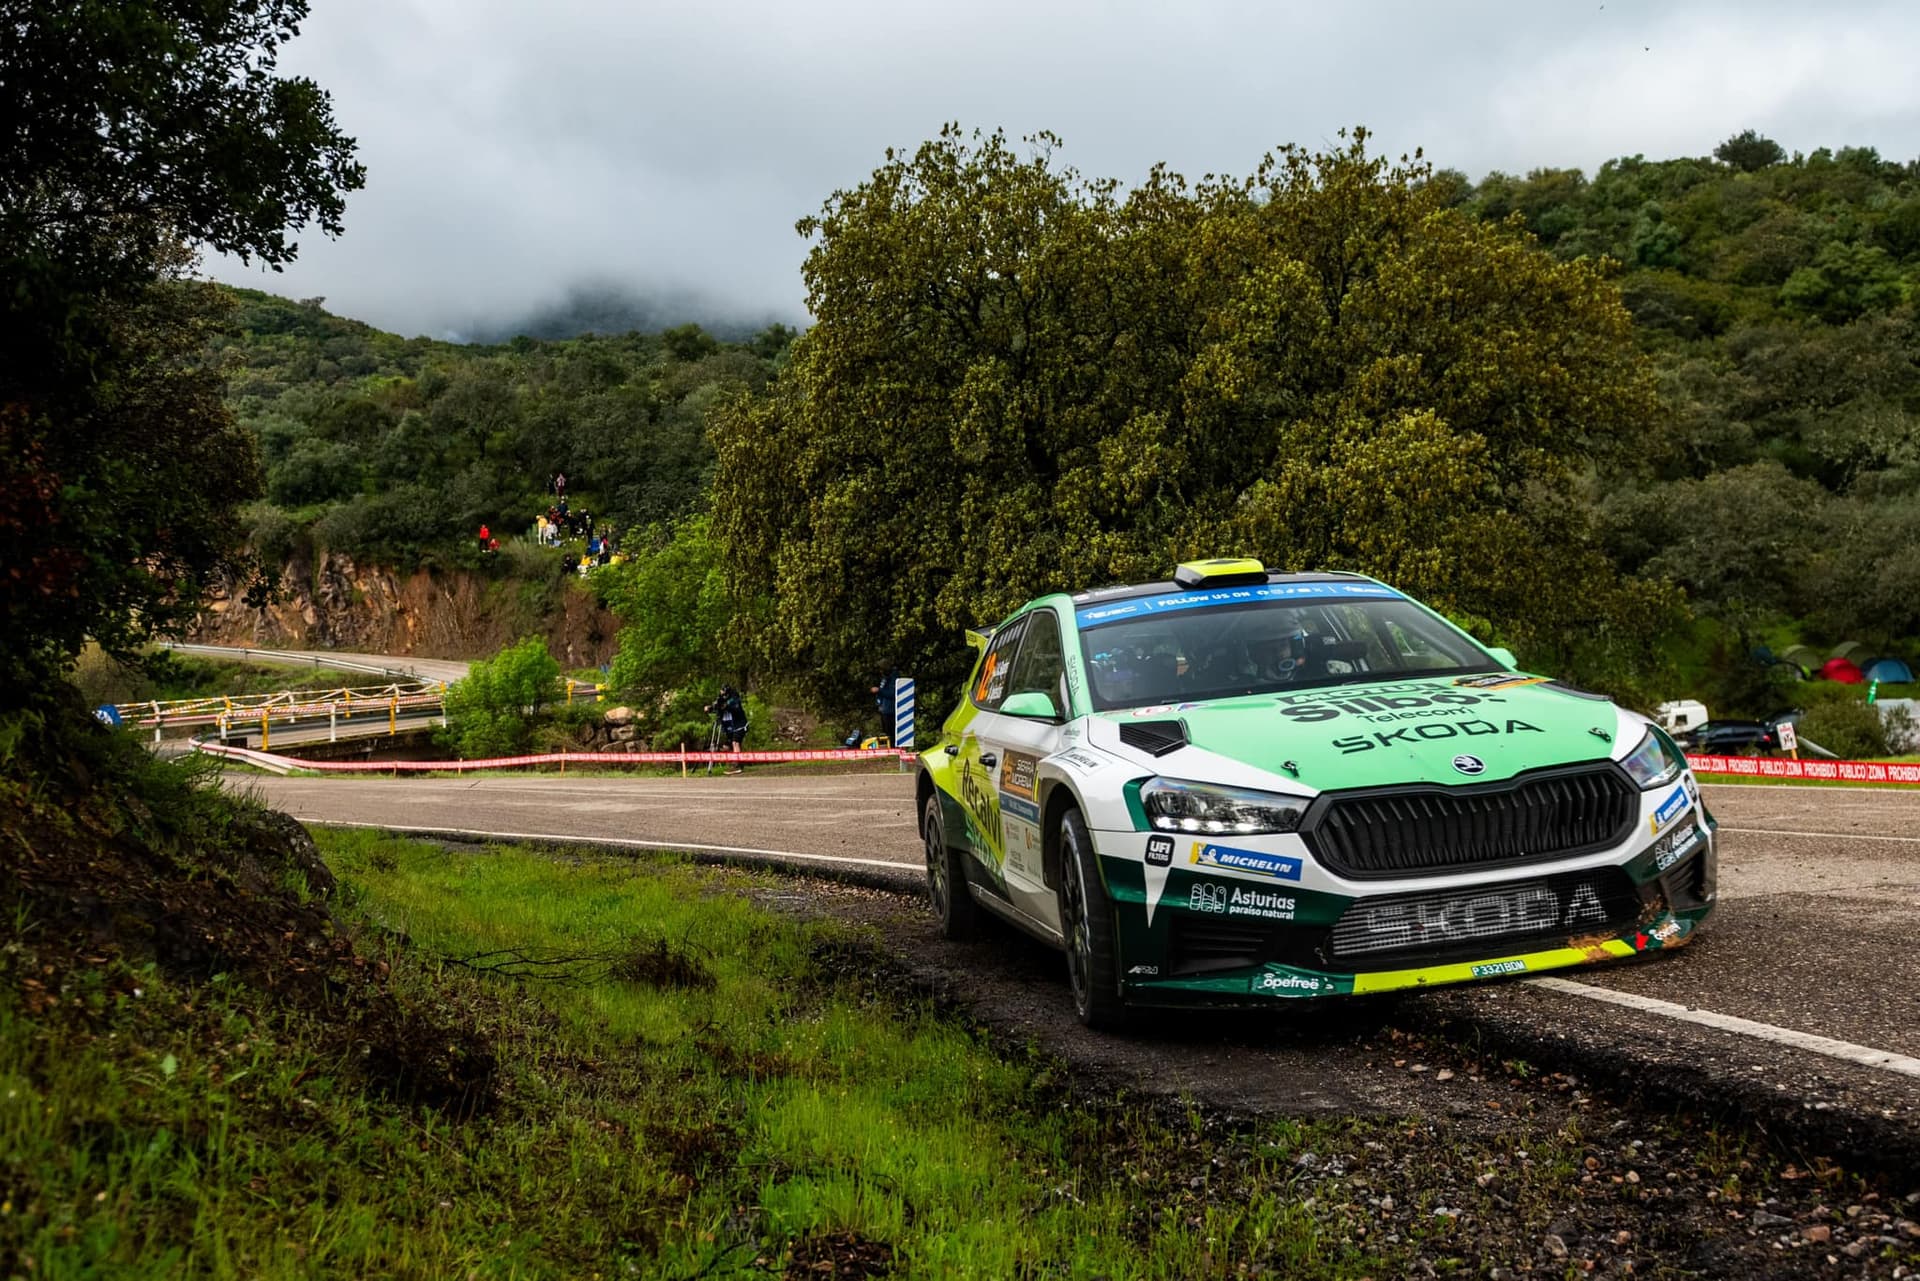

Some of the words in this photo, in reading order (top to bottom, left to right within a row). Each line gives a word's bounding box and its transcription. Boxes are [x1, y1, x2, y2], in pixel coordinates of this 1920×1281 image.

[1157, 595, 1209, 607] FOLLOW
[1213, 592, 1230, 600] US
[1232, 591, 1251, 599] ON
[1357, 706, 1475, 723] Telecom
[1711, 758, 1727, 772] ZONA
[1728, 759, 1758, 774] PROHIBIDO
[1785, 761, 1803, 776] ZONA
[1804, 762, 1837, 778] PROHIBIDO
[1867, 765, 1887, 780] ZONA
[1150, 840, 1171, 854] UFI
[1148, 851, 1169, 861] FILTERS
[1219, 853, 1293, 873] MICHELIN
[1230, 887, 1296, 910] Asturias
[1229, 905, 1261, 915] paraíso
[1262, 909, 1294, 920] natural
